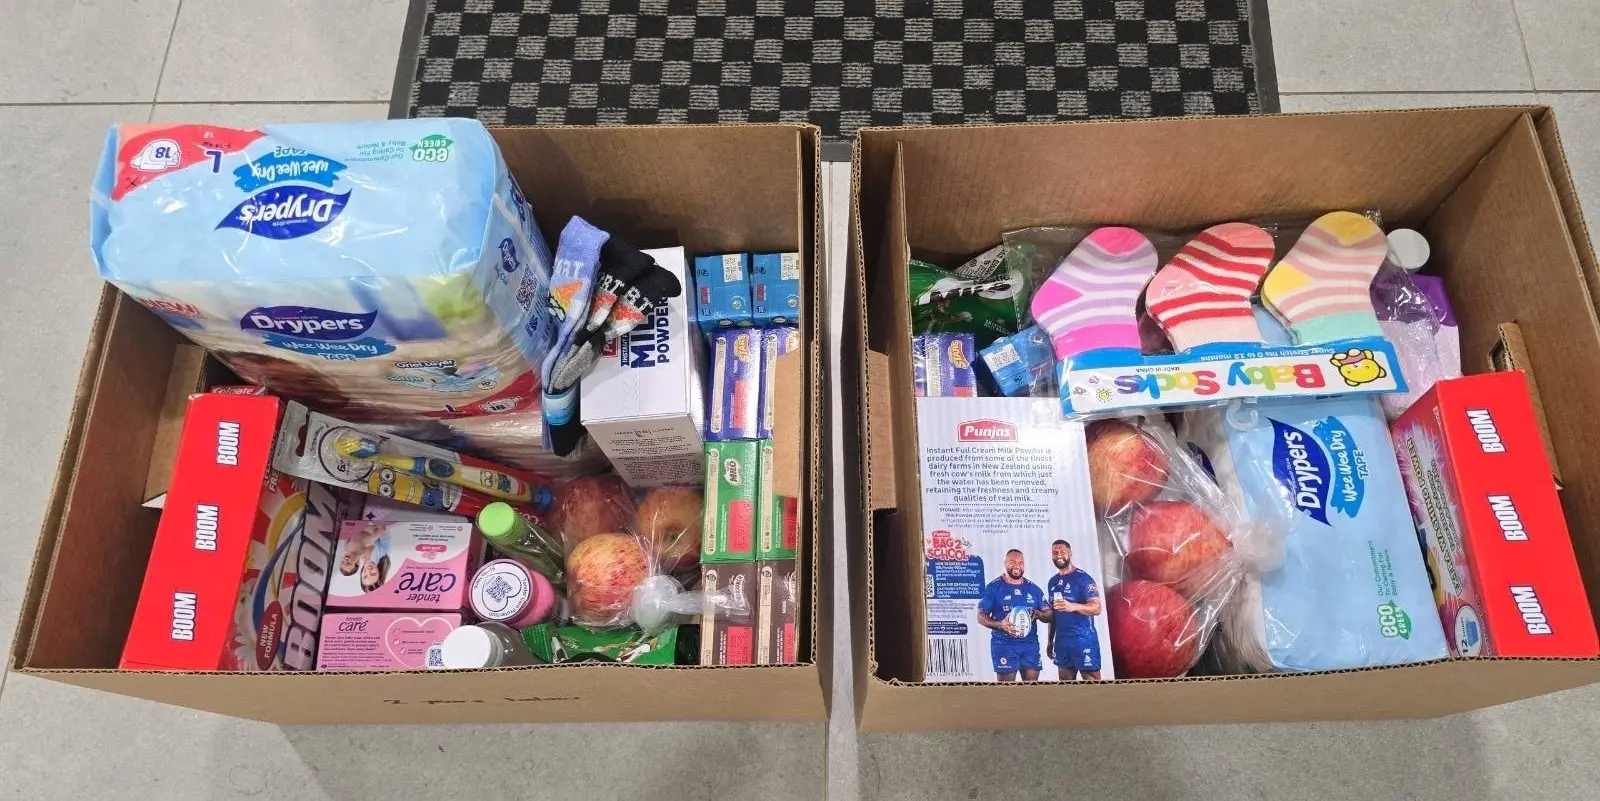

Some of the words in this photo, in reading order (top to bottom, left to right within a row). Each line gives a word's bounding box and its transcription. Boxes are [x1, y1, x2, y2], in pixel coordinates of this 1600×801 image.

[155, 147, 171, 159] 18
[274, 146, 308, 158] TAPE
[417, 139, 447, 147] GREEN
[207, 150, 223, 174] L
[412, 148, 448, 162] eco
[275, 162, 300, 178] Wee
[300, 160, 329, 173] Wee
[238, 192, 334, 224] Drypers
[250, 315, 364, 333] Drypers
[317, 342, 348, 351] Wee
[348, 343, 377, 354] Dry
[631, 315, 655, 368] MIL
[1310, 348, 1335, 356] Super
[1200, 353, 1232, 362] months
[1279, 349, 1309, 357] Stretch
[1134, 366, 1155, 374] CHINA
[1227, 361, 1326, 393] Baby
[1113, 370, 1221, 399] Socks
[964, 426, 1011, 439] Punjas
[1329, 430, 1348, 450] Dry
[1466, 408, 1506, 453] BOOM
[217, 421, 240, 466] BOOM
[729, 461, 737, 482] MILO
[1032, 463, 1052, 471] using
[1285, 431, 1322, 508] Drypers
[1336, 451, 1351, 474] Wee
[1356, 450, 1369, 478] TAPE
[1406, 437, 1424, 486] POWER
[1038, 471, 1052, 479] just
[1341, 474, 1357, 501] Wee
[954, 495, 987, 503] qualities
[195, 504, 219, 551] BOOM
[1421, 487, 1450, 549] WASHING
[1488, 495, 1529, 541] BOOM
[928, 549, 969, 560] SCHOOL
[933, 539, 954, 548] BAG
[955, 540, 962, 549] 2
[1368, 540, 1381, 582] Commitment
[1383, 548, 1392, 571] Nature
[283, 480, 337, 670] BOOM
[398, 572, 456, 593] care
[1380, 564, 1389, 584] Caring
[1440, 551, 1462, 595] EXTRA
[405, 593, 440, 603] tender
[1385, 585, 1391, 596] To
[172, 591, 197, 641] BOOM
[1396, 606, 1408, 633] GREEN
[1511, 585, 1553, 635] BOOM
[338, 621, 366, 632] care
[1377, 605, 1397, 637] eco
[259, 624, 269, 646] NEW
[264, 613, 278, 658] FORMULA
[1460, 640, 1468, 654] 12
